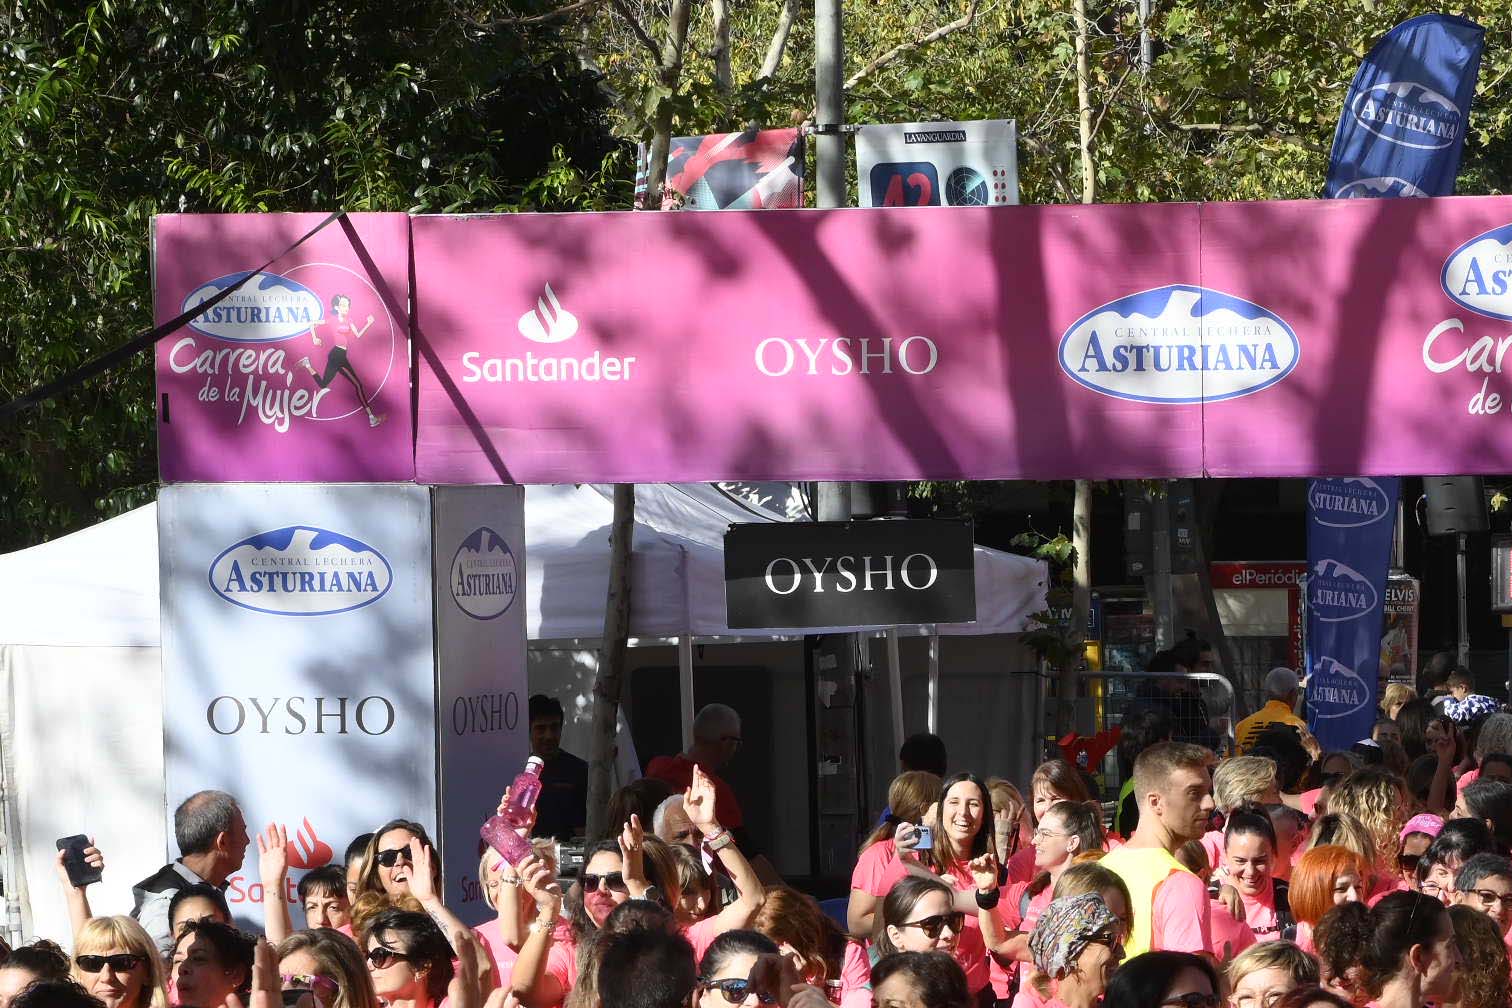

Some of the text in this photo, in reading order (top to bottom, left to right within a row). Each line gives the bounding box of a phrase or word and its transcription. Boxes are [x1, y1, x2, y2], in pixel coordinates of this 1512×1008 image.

[1360, 97, 1455, 140] ASTURIANA
[193, 295, 313, 324] ASTURIANA
[1077, 329, 1281, 374] ASTURIANA
[1114, 325, 1273, 339] CENTRAL LECHERA
[168, 337, 286, 375] Carrera
[462, 349, 637, 383] Santander
[754, 335, 939, 378] OYSHO
[198, 370, 332, 434] de la Mujer
[1467, 376, 1501, 416] de
[223, 558, 380, 594] ASTURIANA
[251, 556, 373, 567] CENTRAL LECHERA
[455, 562, 514, 598] ASTURIANA
[763, 552, 939, 597] OYSHO
[1385, 588, 1415, 601] ELVIS
[206, 695, 396, 737] OYSHO
[452, 691, 519, 737] OYSHO
